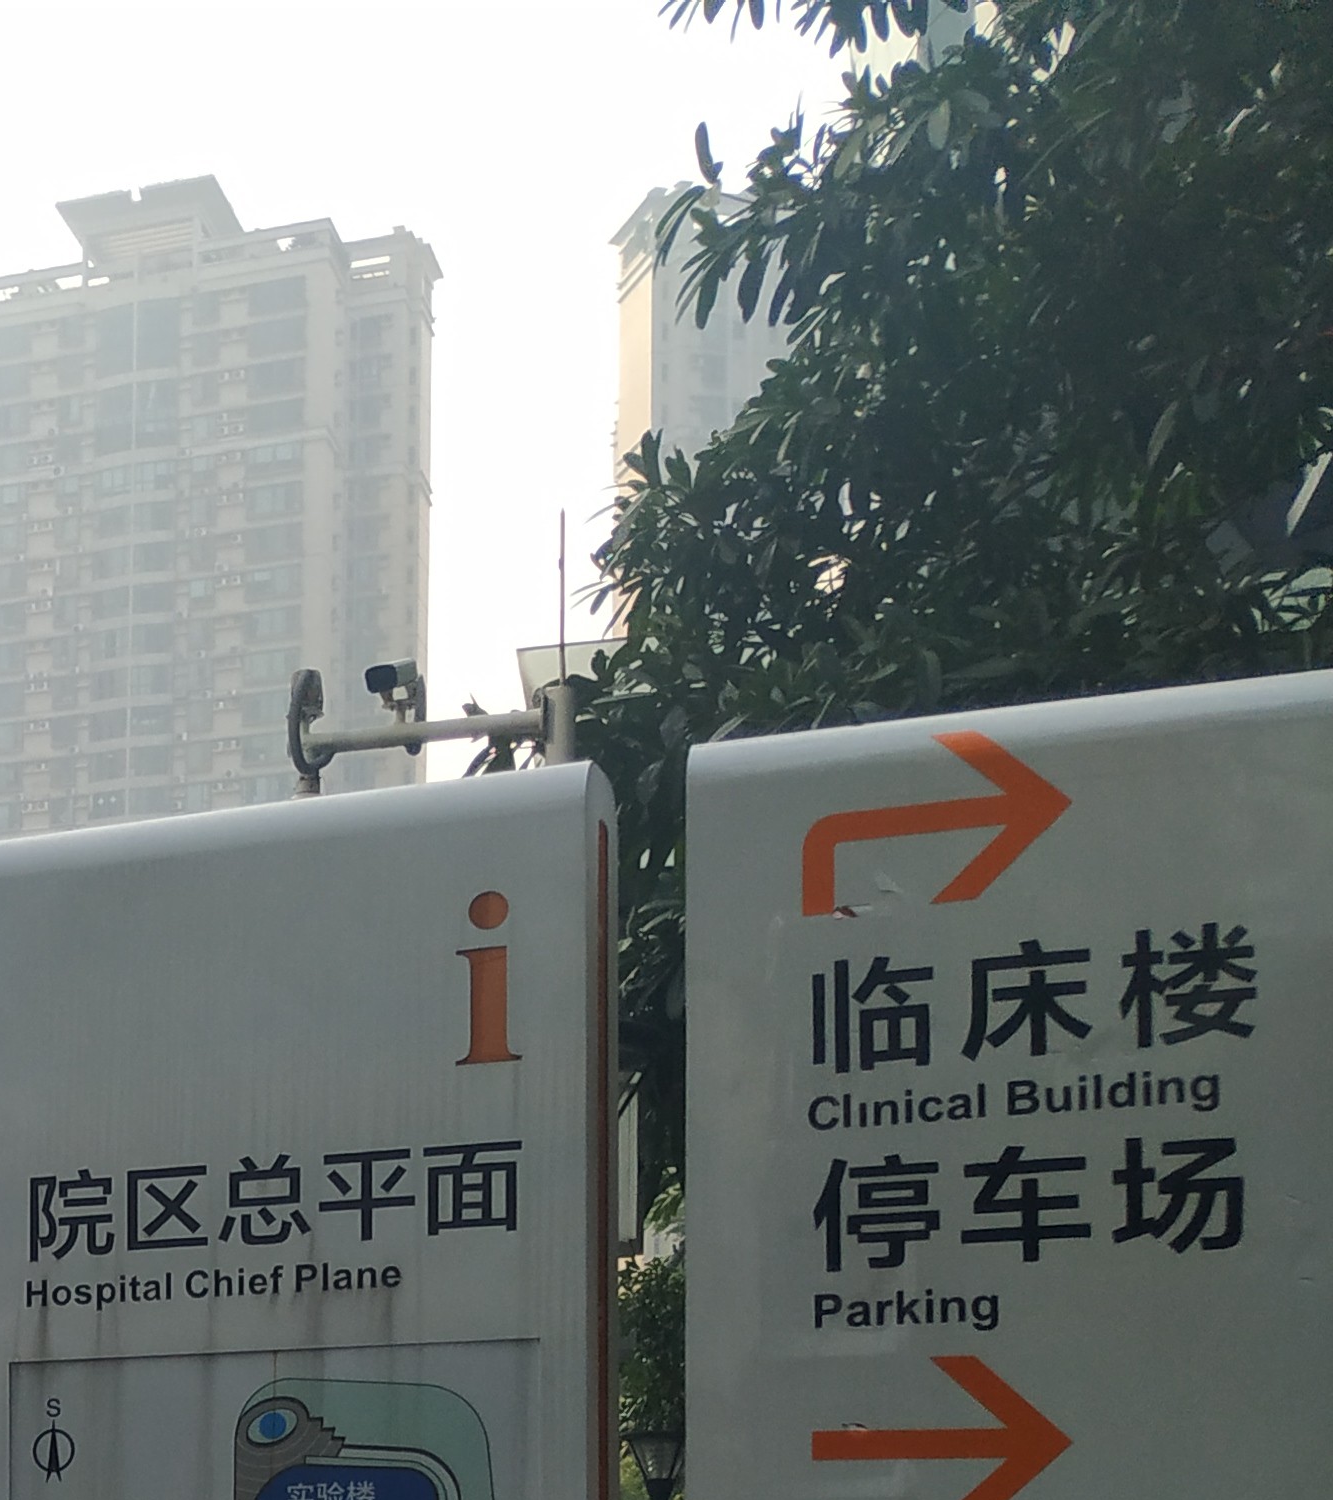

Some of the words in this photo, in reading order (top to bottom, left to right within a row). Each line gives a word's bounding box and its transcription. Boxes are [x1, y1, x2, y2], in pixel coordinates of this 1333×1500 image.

[811, 921, 1258, 1075] 临床楼
[807, 1083, 987, 1132] Clinical
[1006, 1070, 1221, 1117] Building
[28, 1140, 523, 1263] 院区总平面
[812, 1135, 1245, 1274] 停车场
[24, 1272, 173, 1312] Hospital
[184, 1265, 284, 1299] Chief
[294, 1260, 403, 1294] Plane
[813, 1288, 1001, 1332] Parking
[46, 1398, 61, 1418] S
